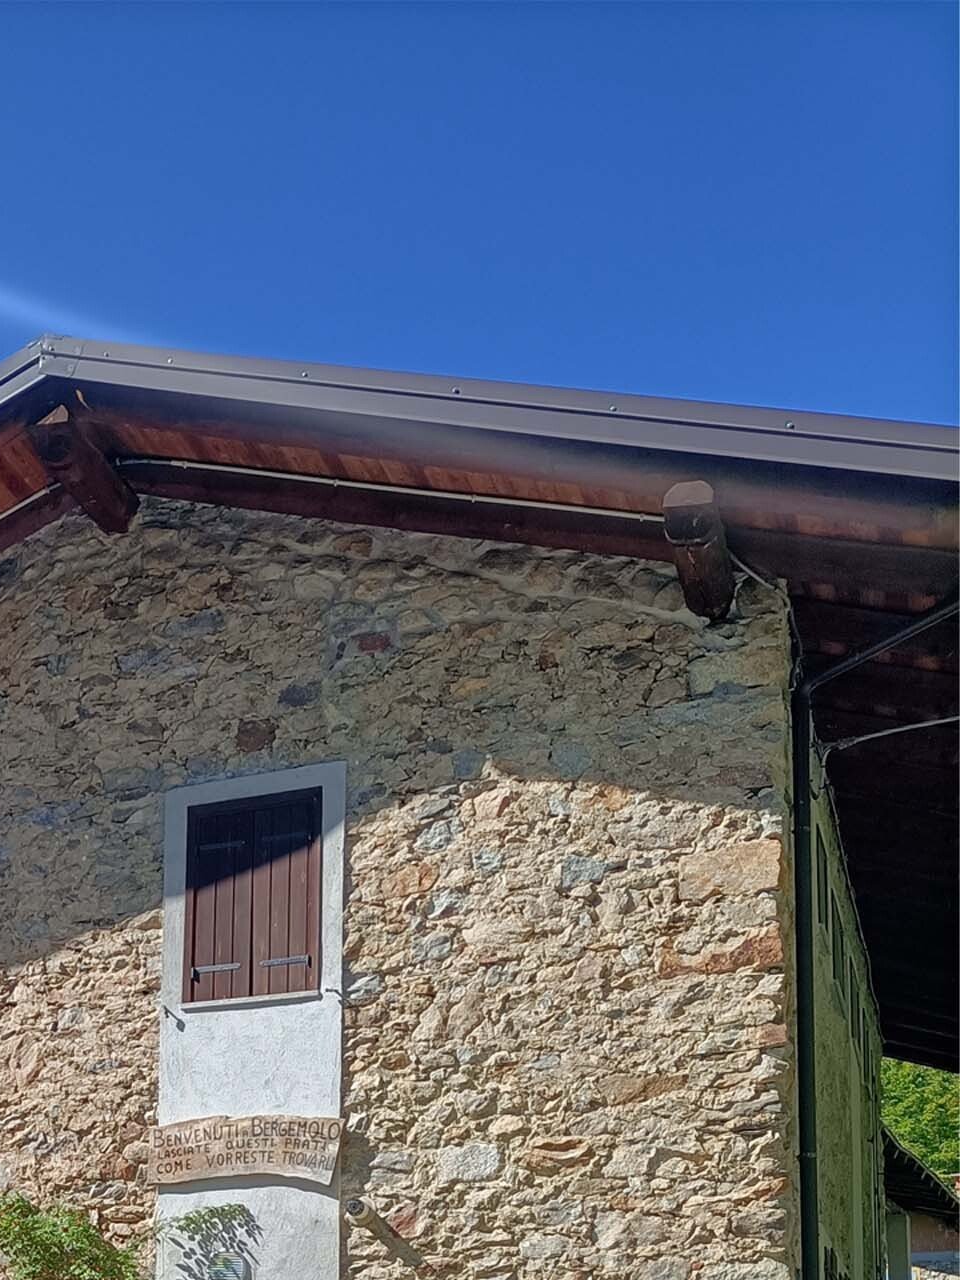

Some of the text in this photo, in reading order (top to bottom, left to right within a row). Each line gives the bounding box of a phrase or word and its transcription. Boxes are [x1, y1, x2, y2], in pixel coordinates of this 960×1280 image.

[153, 1123, 239, 1148] BENVENUTI
[252, 1117, 340, 1140] BERGEMOLO
[157, 1137, 327, 1160] LASCIATE QUESTI PRATI
[156, 1158, 192, 1175] COME
[206, 1150, 275, 1168] VORRESTE
